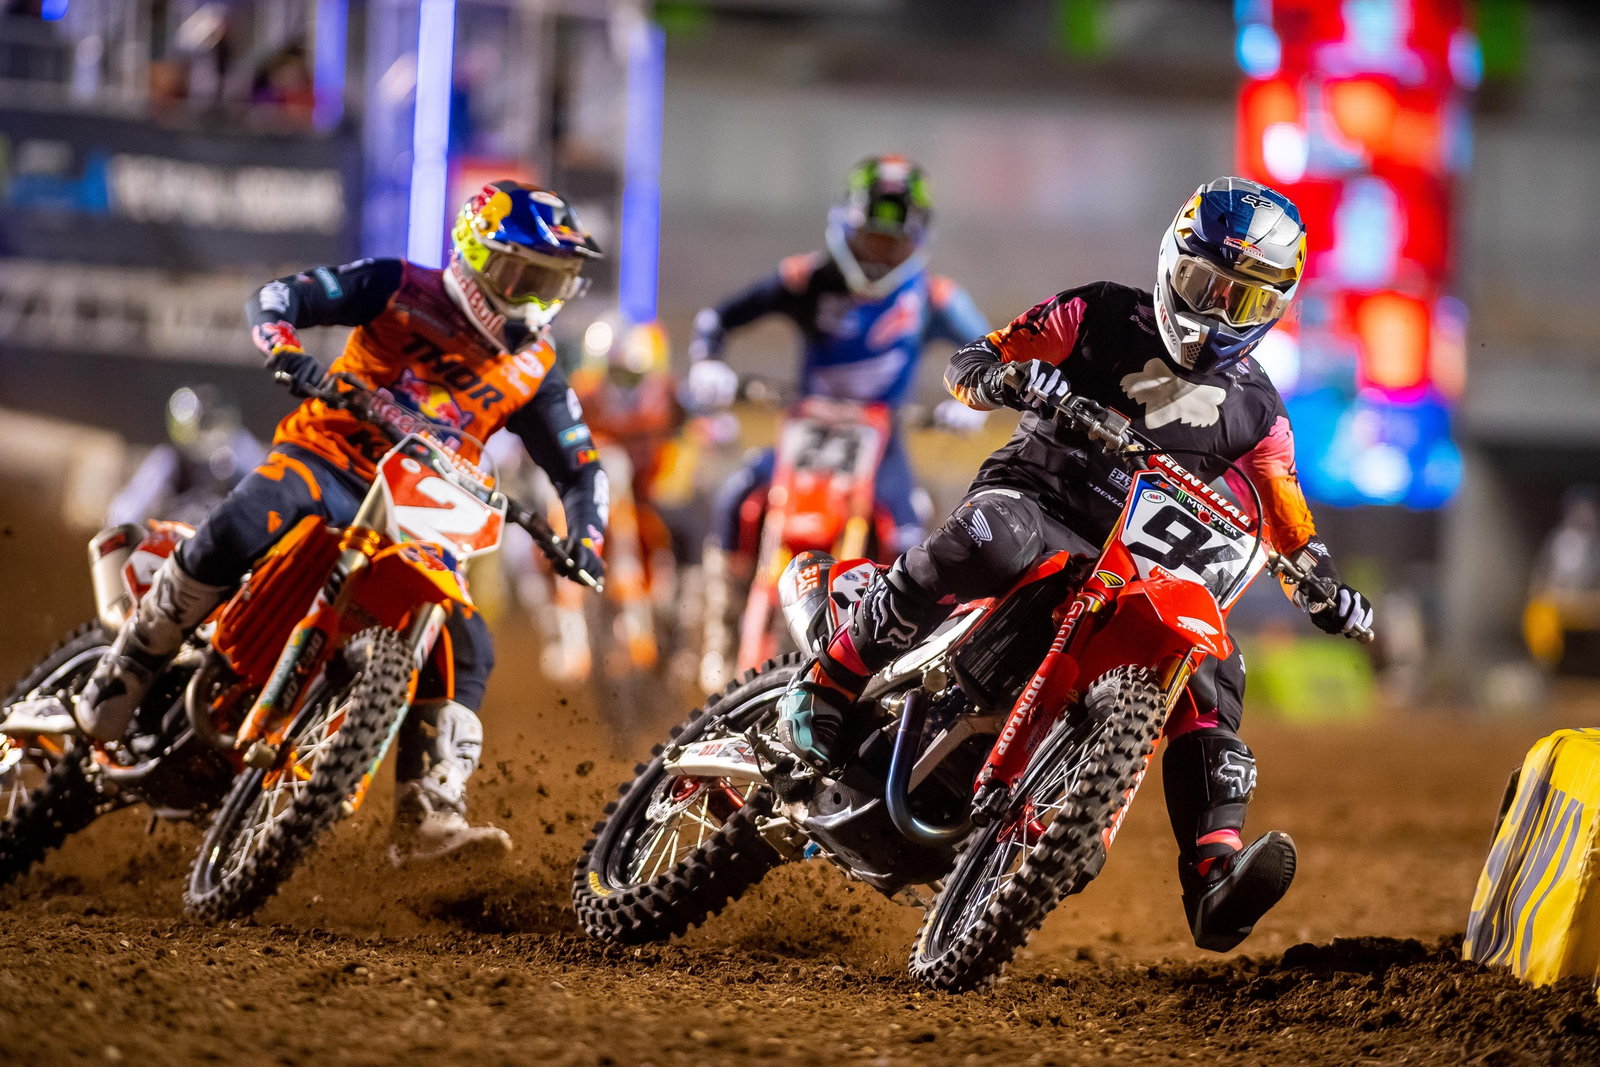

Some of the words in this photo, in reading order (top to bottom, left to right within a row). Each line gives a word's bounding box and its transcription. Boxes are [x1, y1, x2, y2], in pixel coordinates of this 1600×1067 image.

[403, 332, 505, 410] THOR
[394, 476, 489, 558] 2
[1093, 486, 1124, 508] DUNLO
[1156, 453, 1251, 527] RENTHAL
[1186, 498, 1238, 537] MONSTER
[957, 517, 983, 548] HONDA
[1177, 622, 1218, 652] HONDA
[997, 674, 1046, 756] DUNLOP
